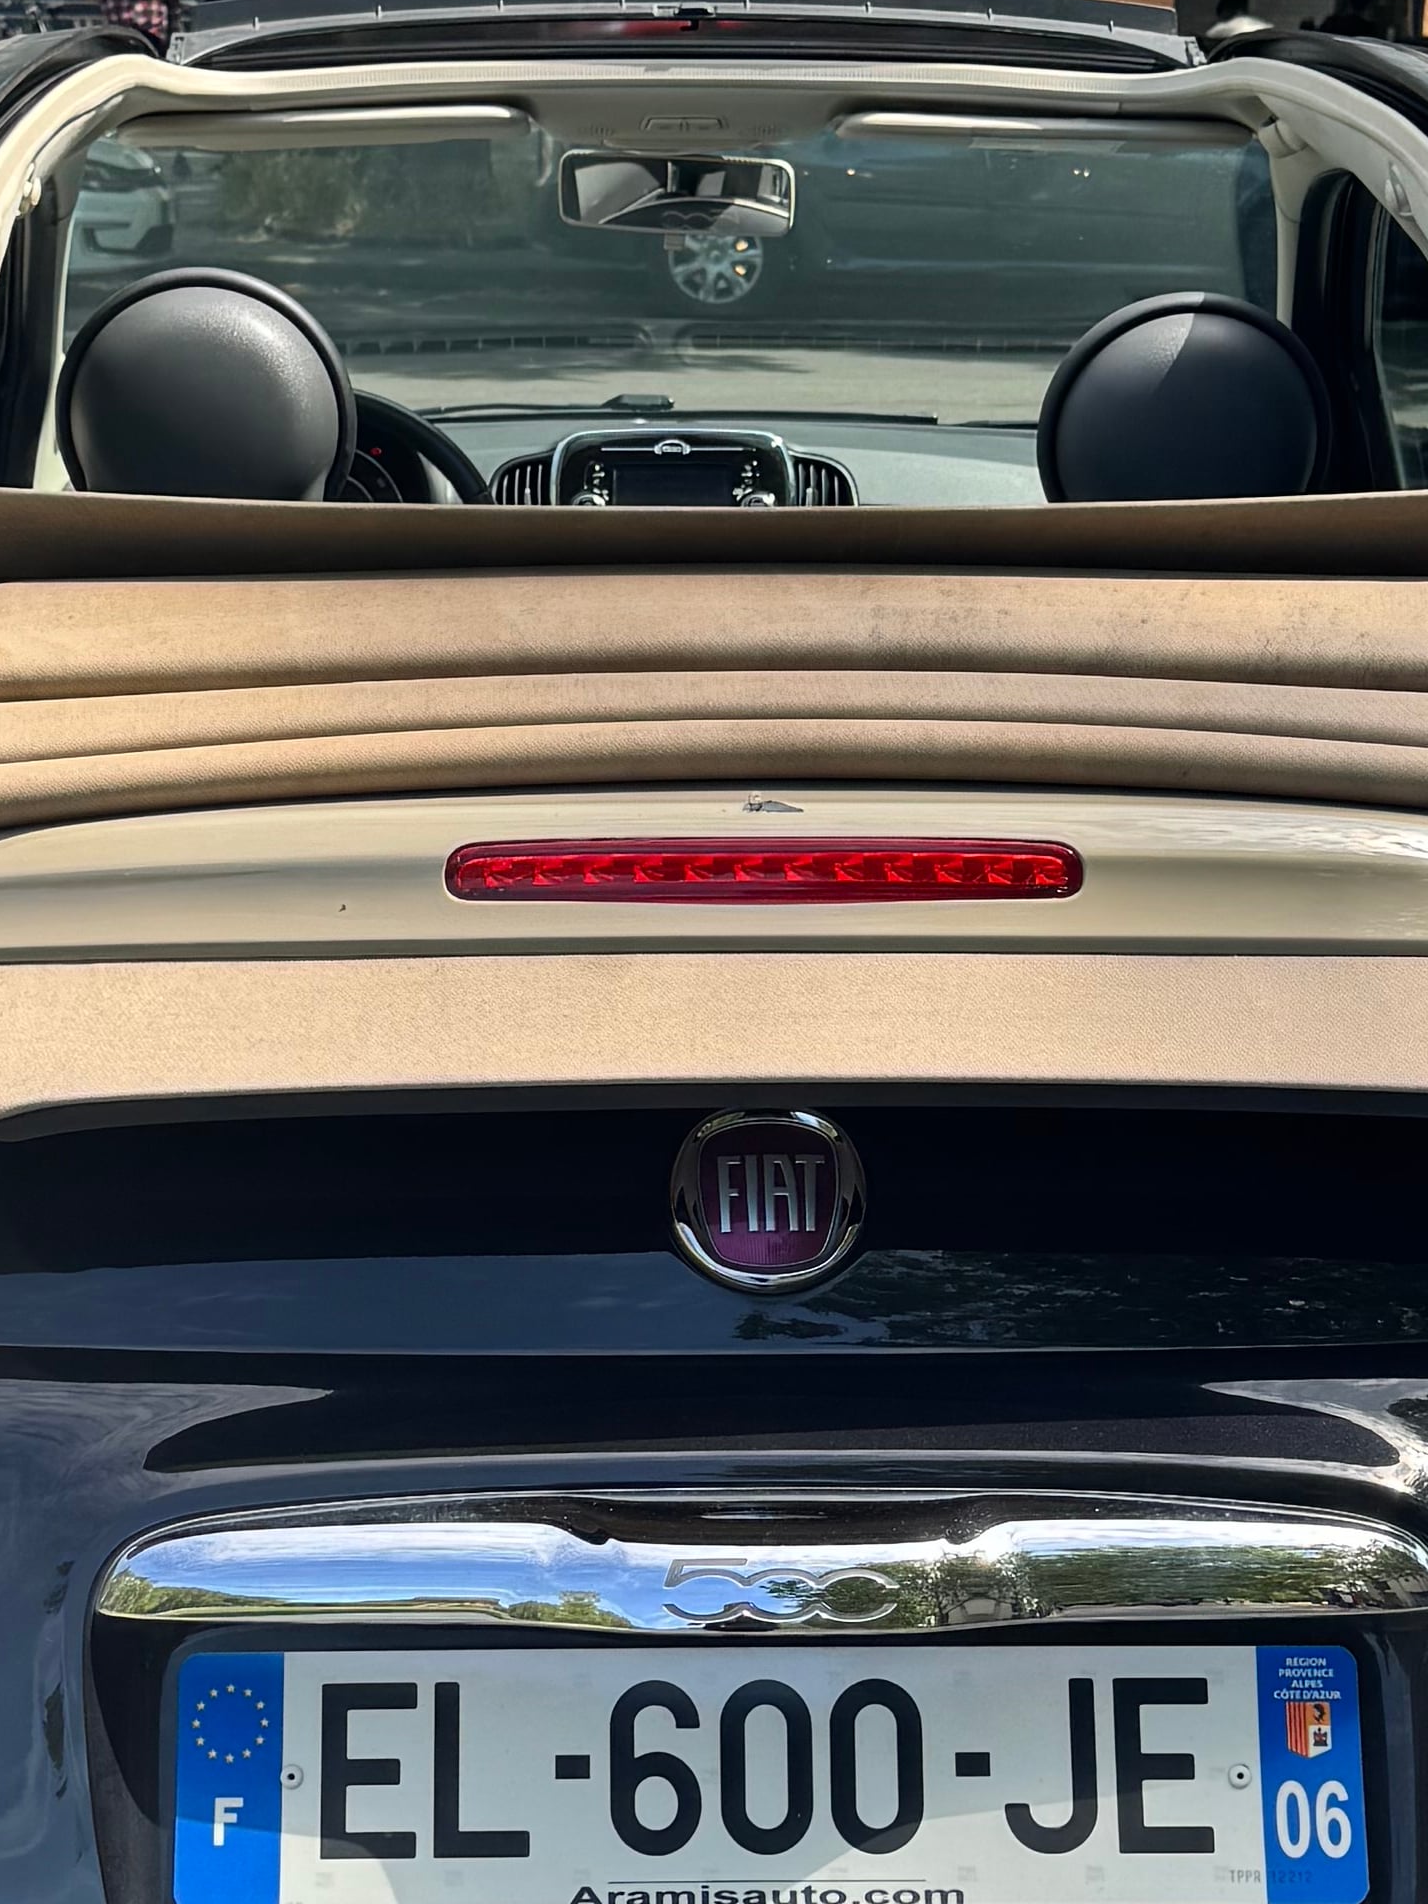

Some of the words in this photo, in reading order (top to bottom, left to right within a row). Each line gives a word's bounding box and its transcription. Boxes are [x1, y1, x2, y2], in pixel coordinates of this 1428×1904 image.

[717, 1154, 826, 1233] FIAT
[662, 1557, 900, 1624] 500
[1278, 1668, 1334, 1677] PROVENCE
[1291, 1679, 1324, 1688] ALPES
[213, 1797, 244, 1846] F
[1275, 1779, 1353, 1859] 06
